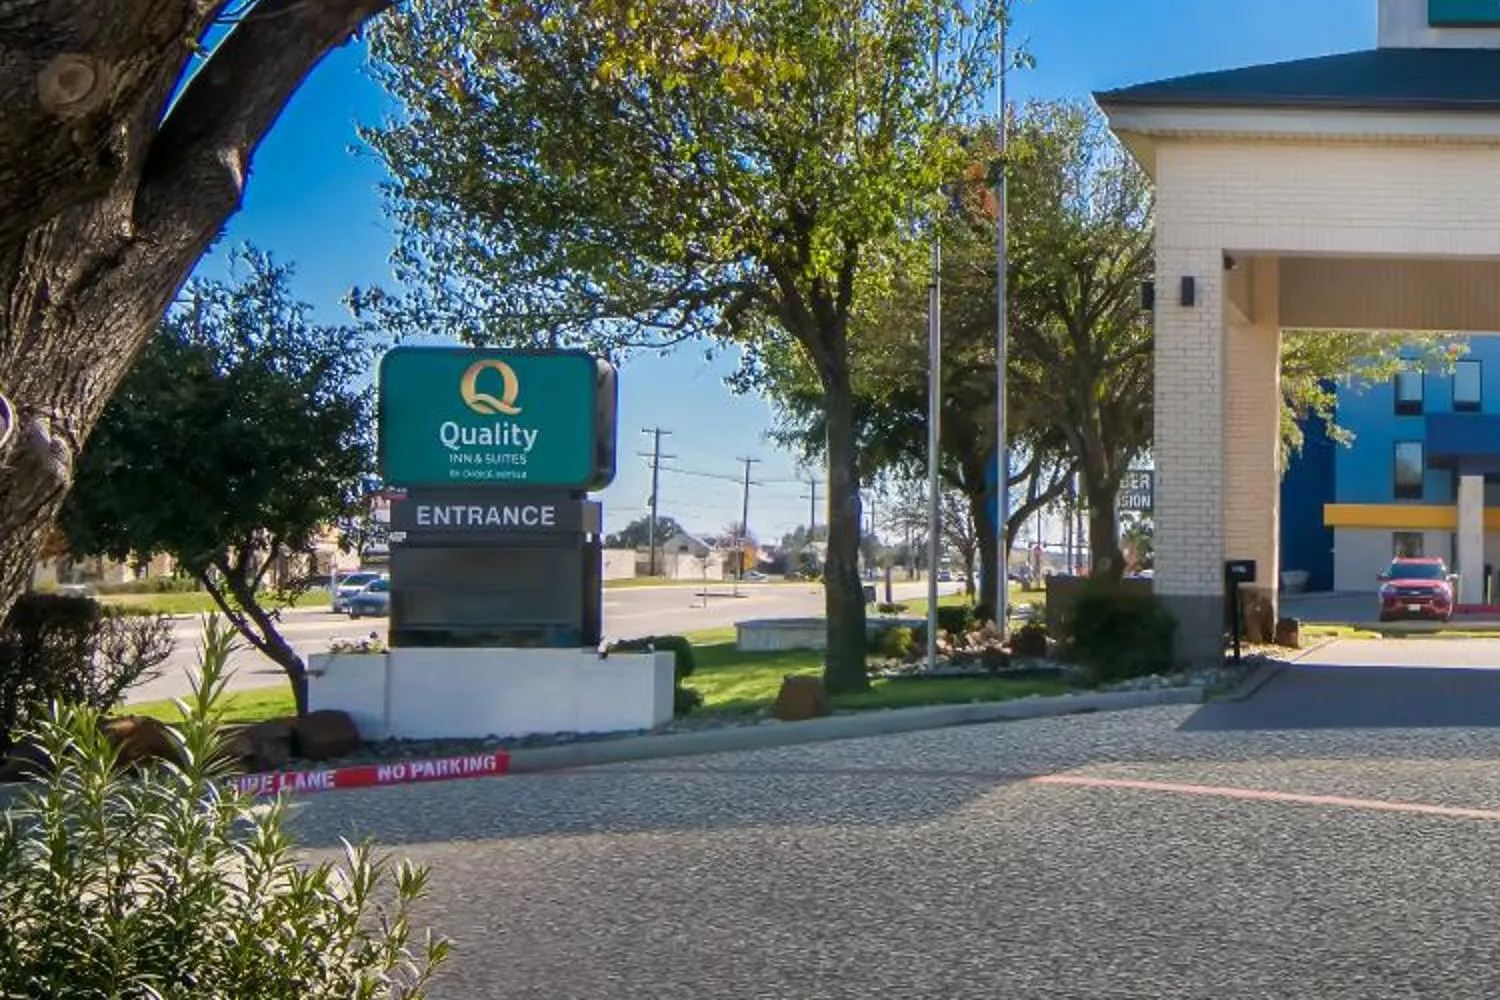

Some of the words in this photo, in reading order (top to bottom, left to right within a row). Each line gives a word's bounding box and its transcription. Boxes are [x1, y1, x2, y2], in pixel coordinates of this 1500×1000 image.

[460, 359, 523, 415] Q
[439, 421, 539, 453] Quality
[449, 453, 473, 464] INN
[474, 453, 483, 465] &
[484, 453, 528, 465] SUITES
[415, 504, 556, 526] ENTRANCE
[1120, 494, 1152, 509] SION
[232, 773, 274, 793] IRE
[377, 763, 405, 781] NO
[411, 754, 497, 780] PARKING
